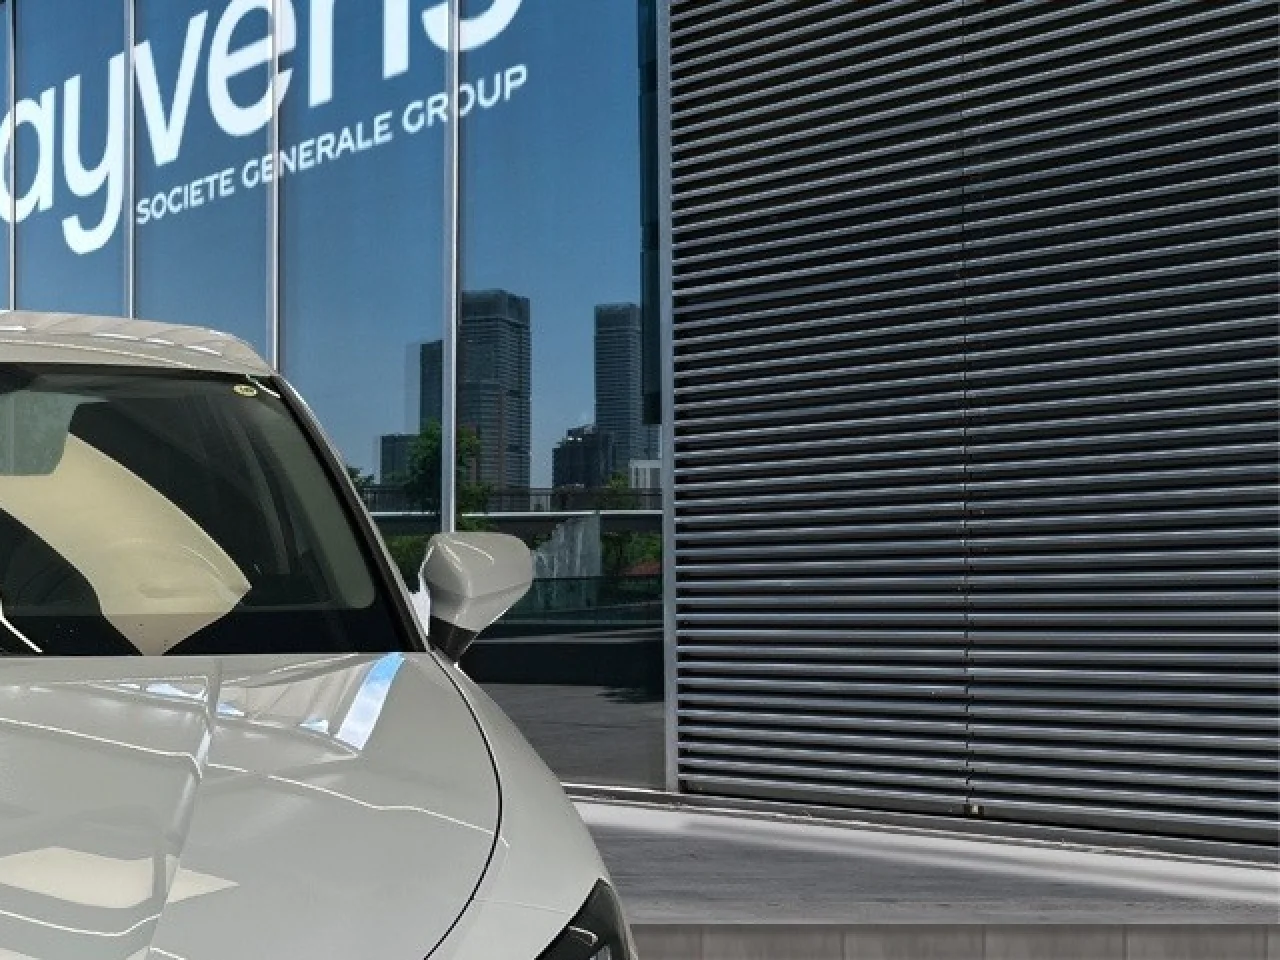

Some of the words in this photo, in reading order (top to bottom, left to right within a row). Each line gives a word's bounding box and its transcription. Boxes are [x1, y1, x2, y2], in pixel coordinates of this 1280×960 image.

[135, 167, 235, 225] SOCIETE
[242, 110, 394, 189] GENERALE
[401, 63, 528, 134] GROUP
